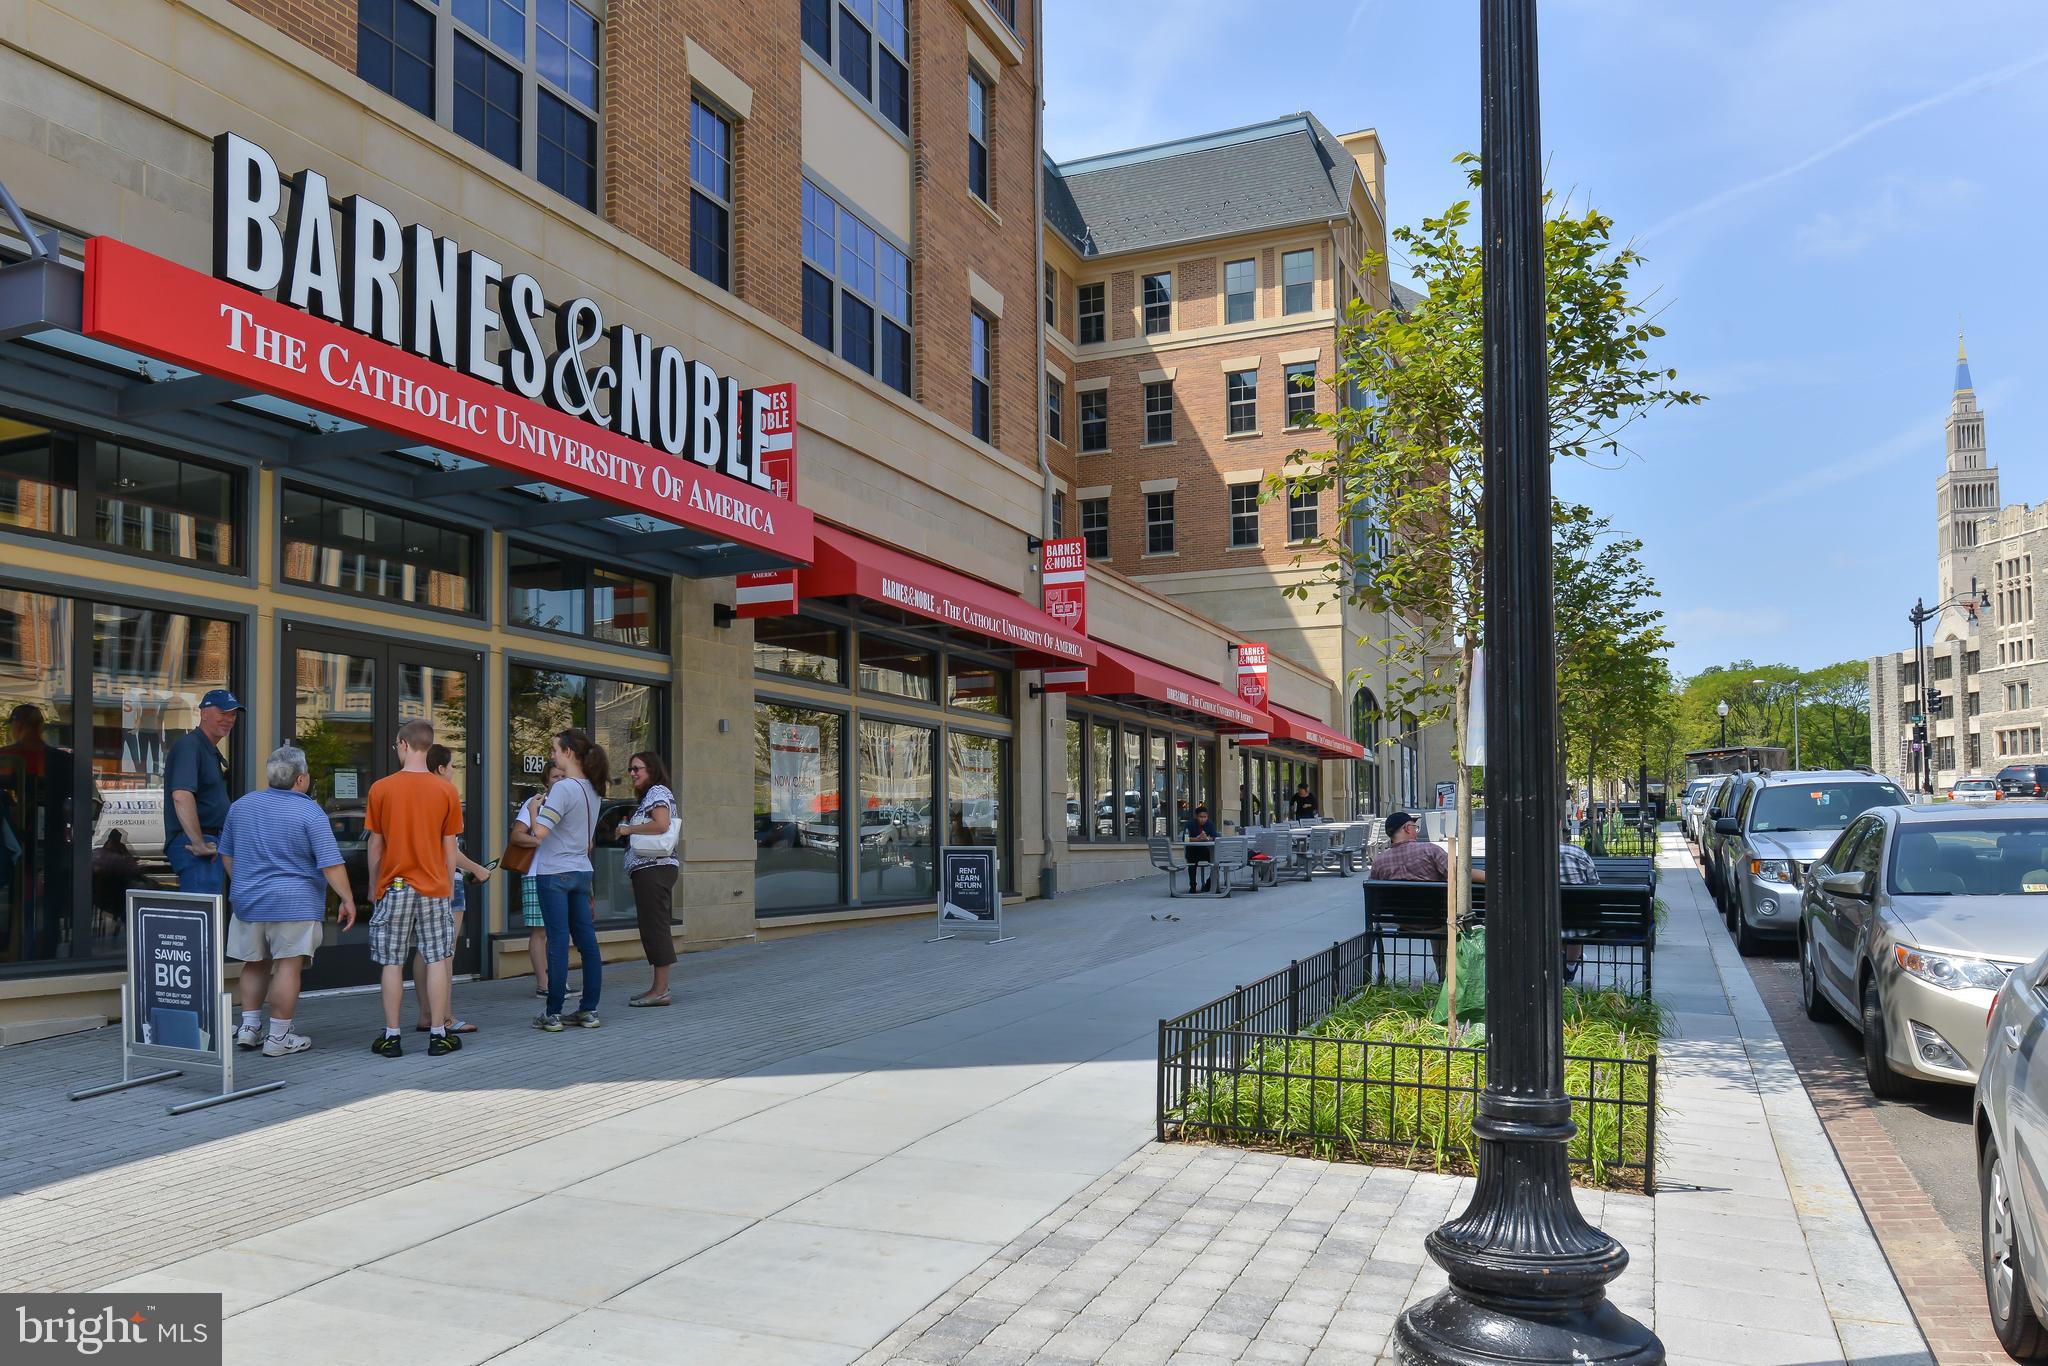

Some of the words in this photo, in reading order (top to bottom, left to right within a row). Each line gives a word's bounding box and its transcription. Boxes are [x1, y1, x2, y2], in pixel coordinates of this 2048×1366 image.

[220, 303, 307, 373] THE
[319, 343, 488, 435] CATHOLIC
[495, 405, 646, 490] UNIVERSITY
[652, 465, 684, 502] OF
[688, 479, 775, 535] AMERICA
[1046, 542, 1081, 557] BARNES
[943, 600, 961, 620] THE
[963, 606, 1001, 632] CATHOLIC
[1002, 619, 1042, 646] UNIVERSITY
[1055, 636, 1082, 657] AMERICA
[1240, 647, 1264, 655] BARNES
[525, 756, 543, 772] 625
[155, 948, 192, 962] SAVING
[155, 963, 192, 988] BIG
